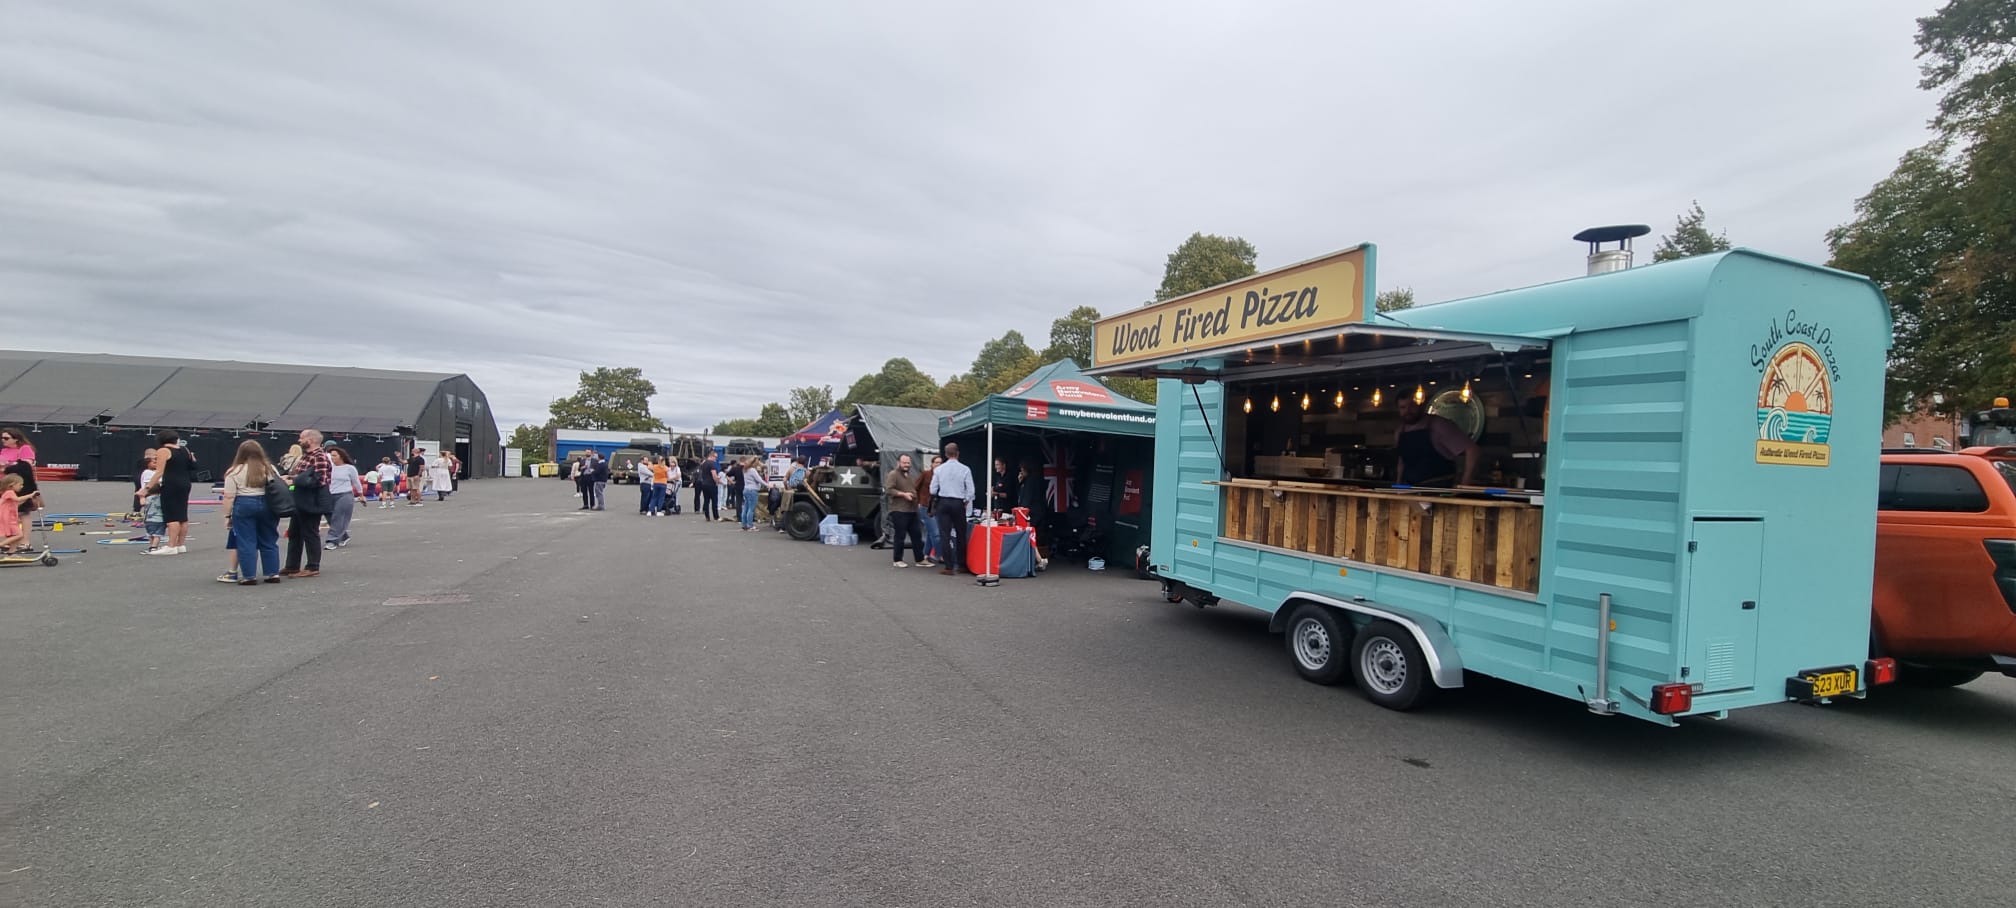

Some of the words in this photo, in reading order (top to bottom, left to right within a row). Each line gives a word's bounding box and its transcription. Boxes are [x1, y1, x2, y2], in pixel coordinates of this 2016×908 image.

[1112, 314, 1162, 356] Wood
[1173, 296, 1232, 344] Fired
[1241, 286, 1319, 329] Pizza
[1750, 317, 1783, 373] South
[1785, 309, 1818, 340] Coast
[1816, 327, 1841, 382] Pizzas
[1059, 408, 1156, 424] armybenevolentfund.or
[1833, 674, 1851, 690] XUR
